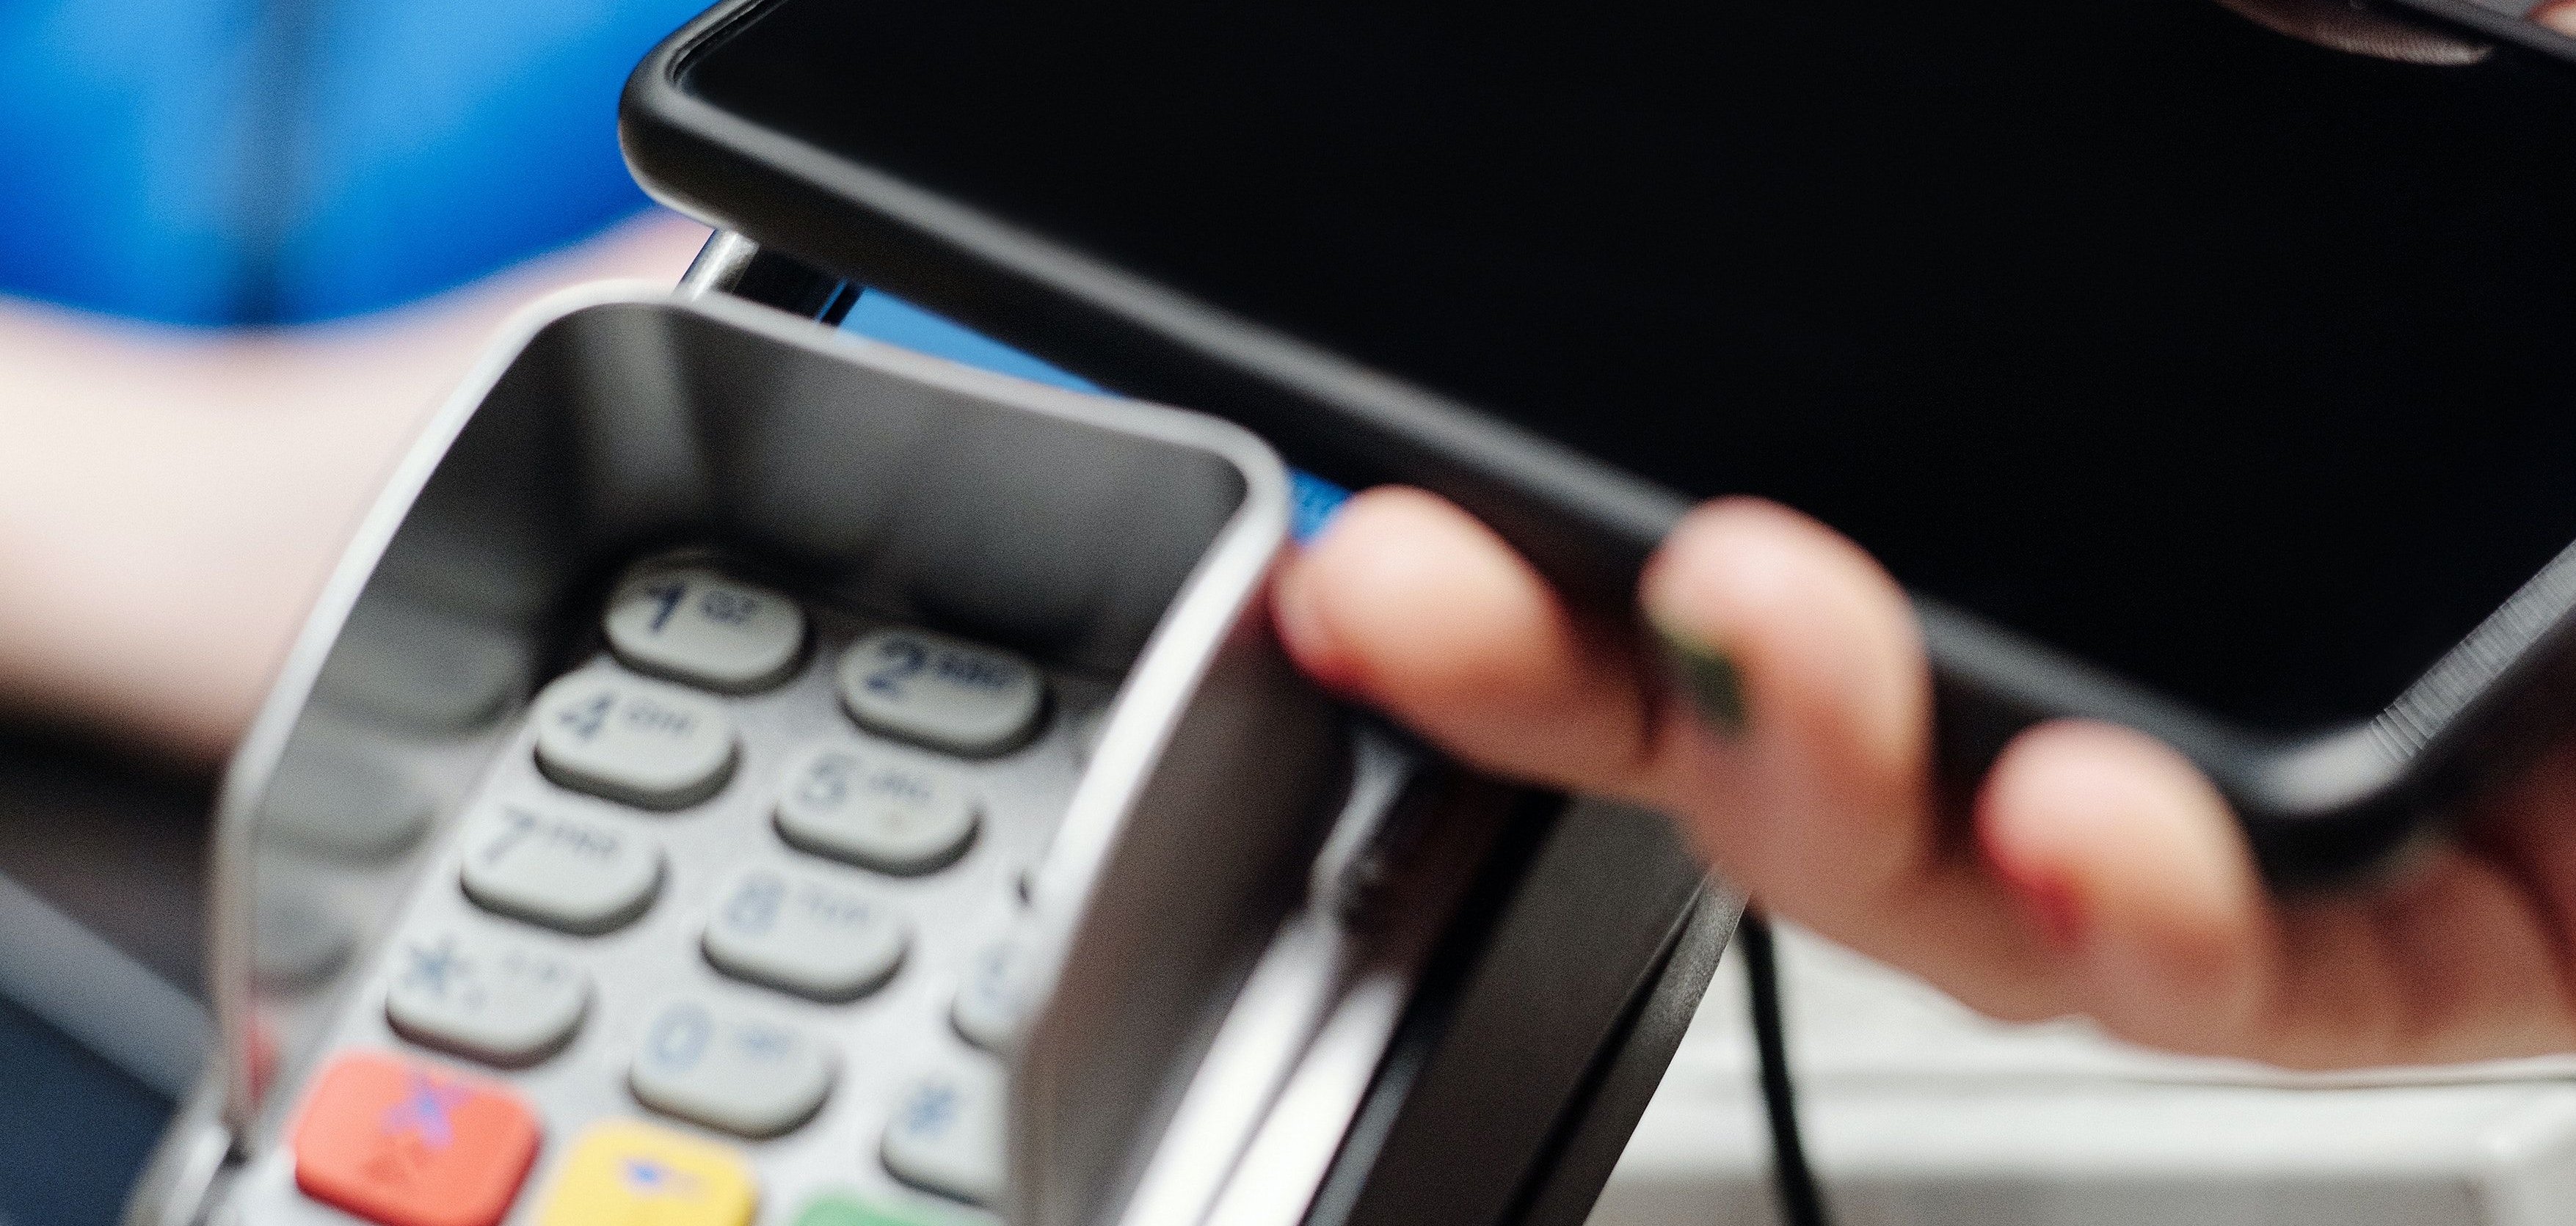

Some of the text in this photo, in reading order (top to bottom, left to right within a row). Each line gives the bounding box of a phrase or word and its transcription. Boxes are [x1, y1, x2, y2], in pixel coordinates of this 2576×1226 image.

[644, 581, 688, 634] 1
[862, 637, 929, 697] 2
[556, 691, 615, 742] 4
[796, 751, 862, 813] 5
[481, 803, 539, 867] 7
[722, 870, 788, 938] 8
